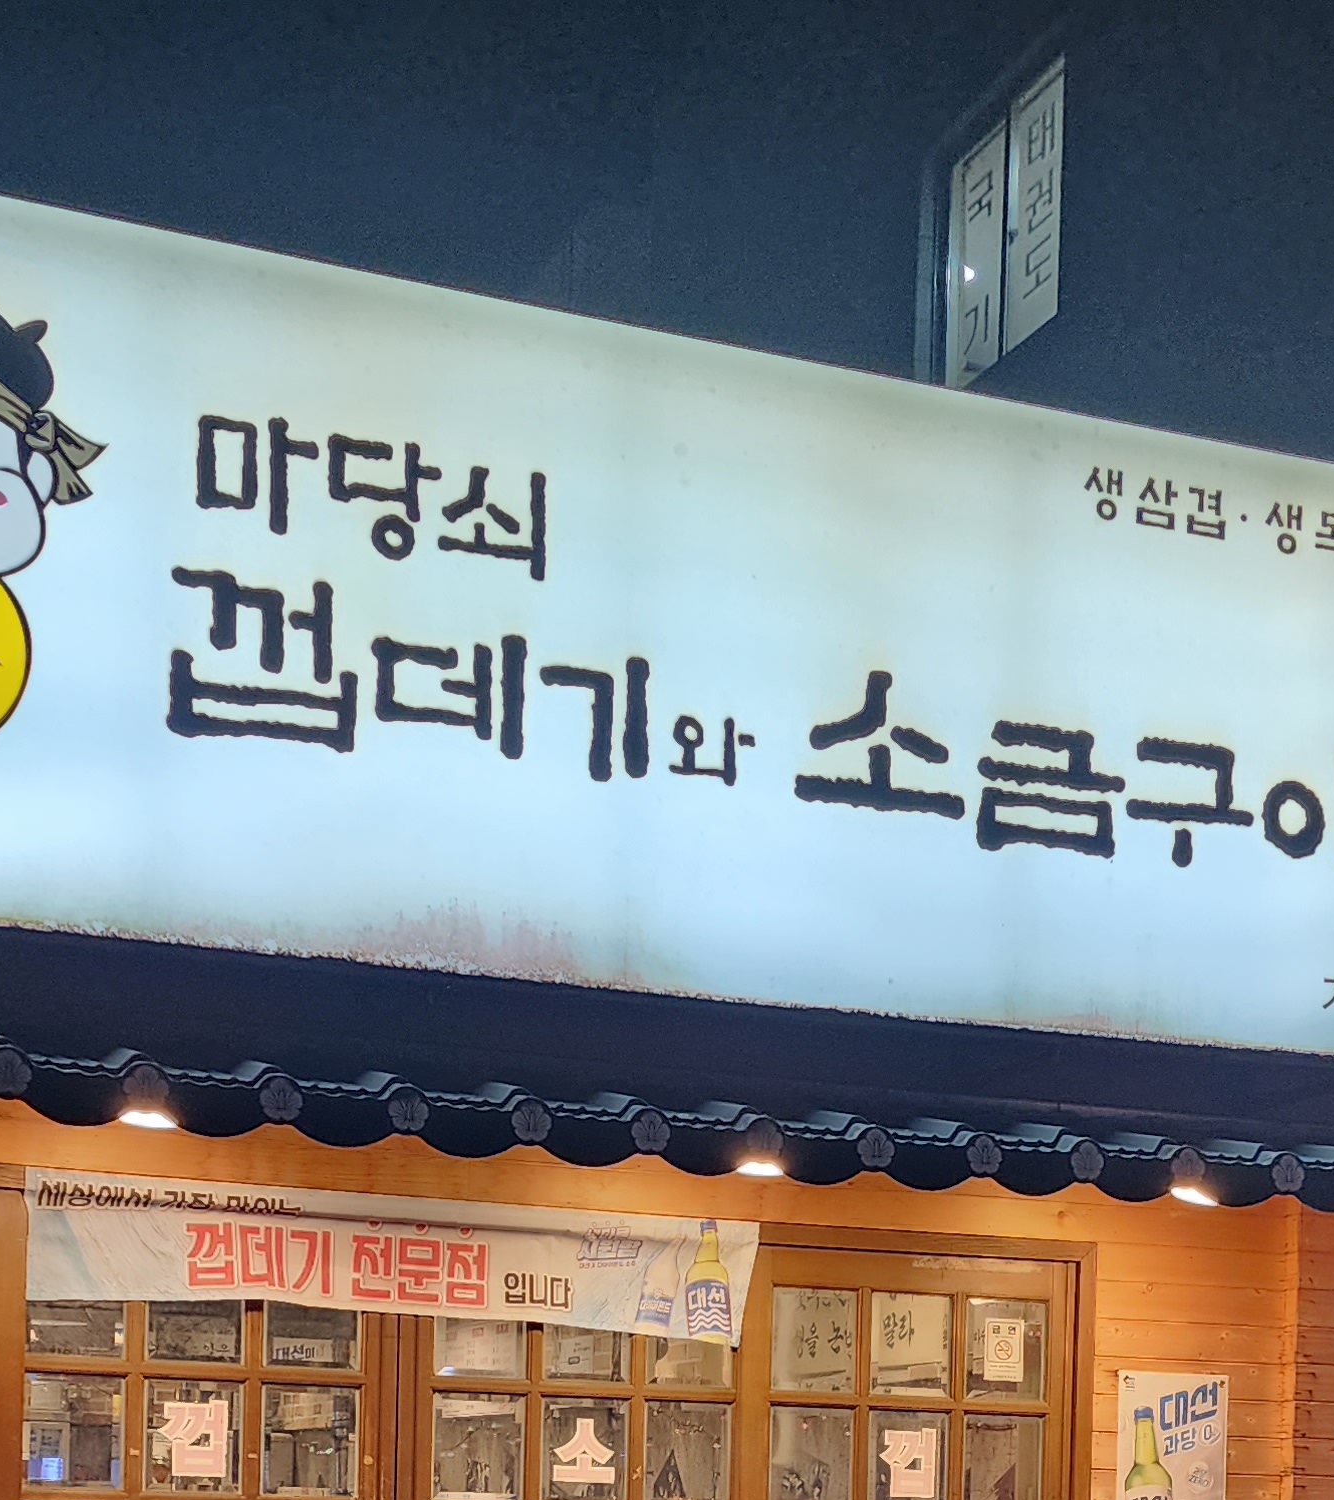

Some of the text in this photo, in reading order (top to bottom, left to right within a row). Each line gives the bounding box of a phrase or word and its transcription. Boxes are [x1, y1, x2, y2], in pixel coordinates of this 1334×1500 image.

[196, 414, 546, 581] 마당쇠
[167, 566, 755, 785] 껍데기와
[186, 1222, 573, 1309] 껍데기 전문점 입니다
[688, 1287, 727, 1311] 대선
[1160, 1381, 1218, 1431] 대선
